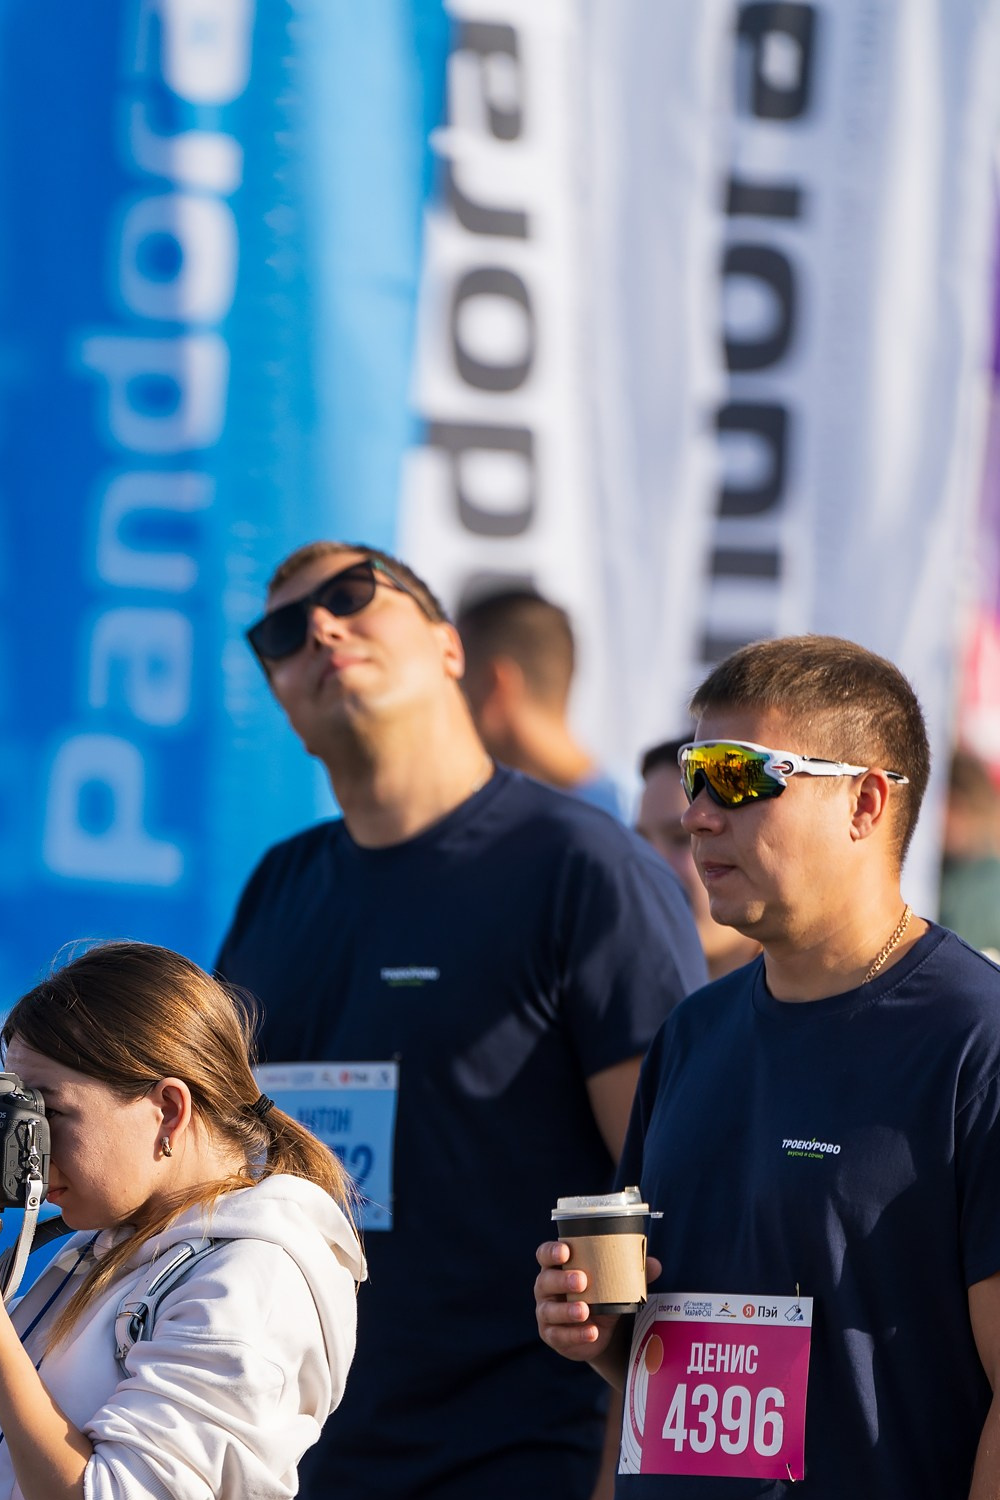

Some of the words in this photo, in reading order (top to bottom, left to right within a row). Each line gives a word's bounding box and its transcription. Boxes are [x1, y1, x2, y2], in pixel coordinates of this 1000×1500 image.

[428, 20, 538, 604] dora
[781, 1139, 841, 1154] ТРОЕКУРОВО
[758, 1305, 778, 1318] Пэй
[687, 1342, 759, 1375] ДЕНИС
[662, 1383, 785, 1457] 4396
